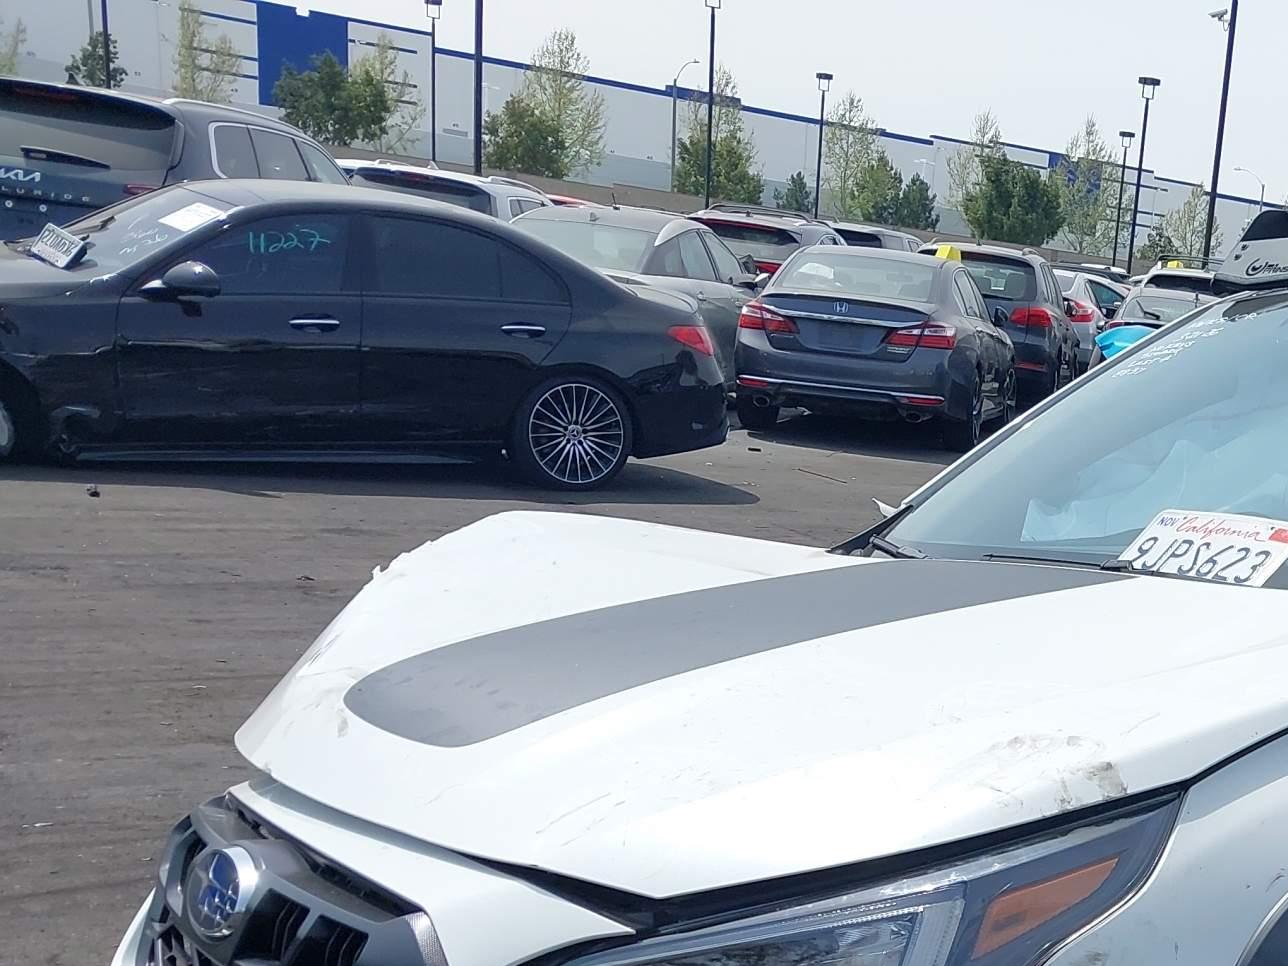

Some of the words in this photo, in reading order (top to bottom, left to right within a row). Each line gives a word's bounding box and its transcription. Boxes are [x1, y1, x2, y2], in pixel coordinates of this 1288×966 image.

[249, 228, 331, 254] 11227
[1156, 516, 1178, 527] NOV
[1175, 516, 1267, 543] California
[1131, 536, 1273, 583] 9JPS623
